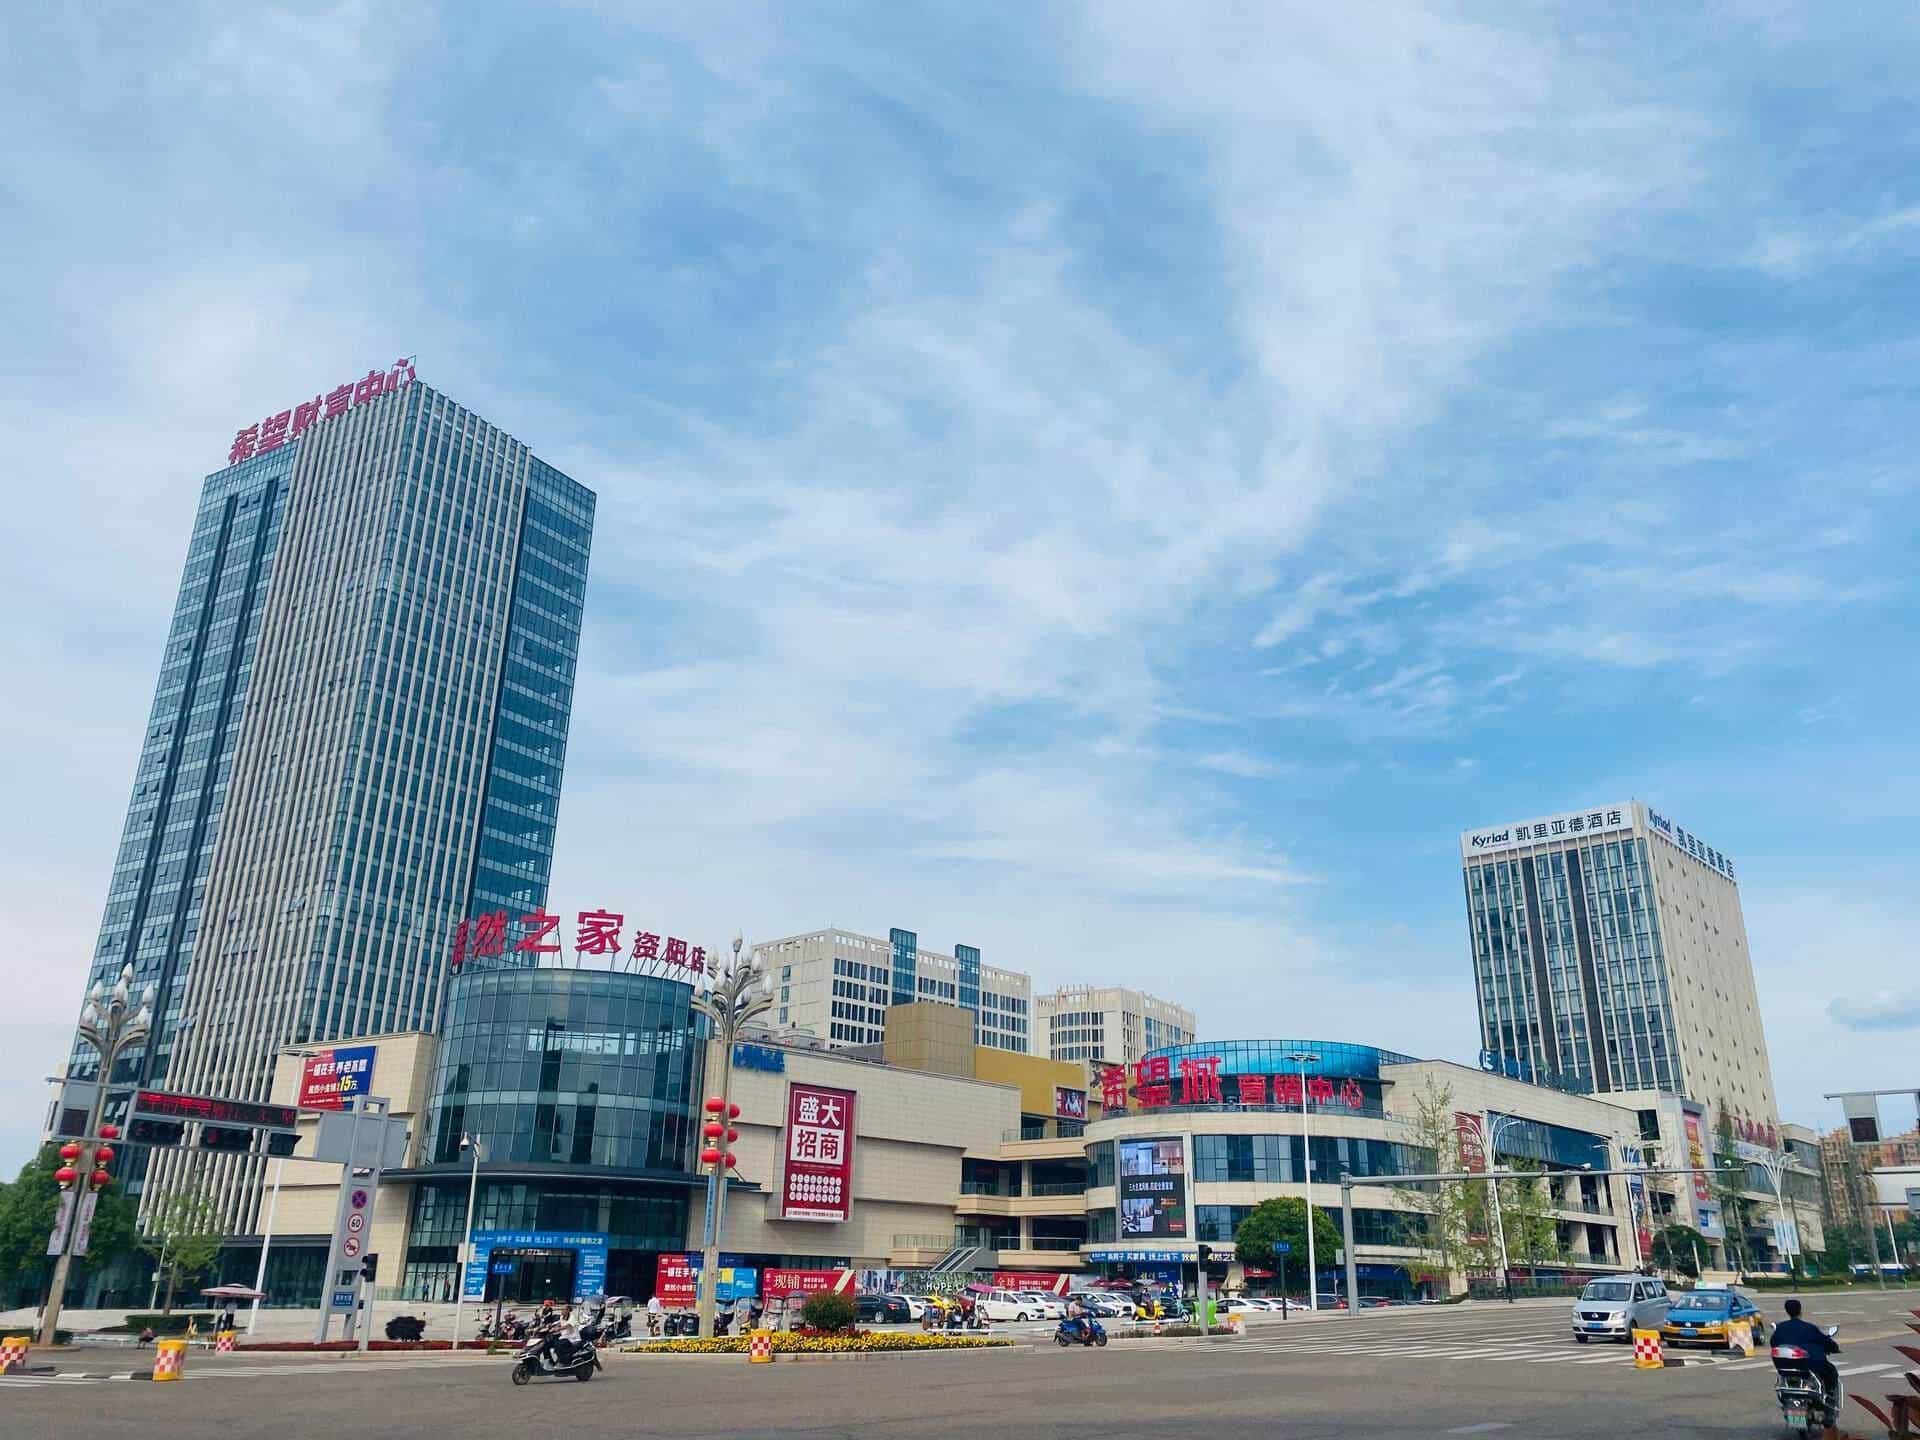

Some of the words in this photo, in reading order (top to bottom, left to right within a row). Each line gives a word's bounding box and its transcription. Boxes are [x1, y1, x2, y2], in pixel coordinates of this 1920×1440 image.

[228, 354, 417, 465] 希望财富中心
[1471, 829, 1510, 849] Kyriad
[1515, 809, 1622, 841] 凯里亚德酒店
[1648, 807, 1672, 834] Kyriad
[798, 1096, 841, 1127] 盛大
[796, 1129, 840, 1160] 招商
[351, 1219, 361, 1228] 60
